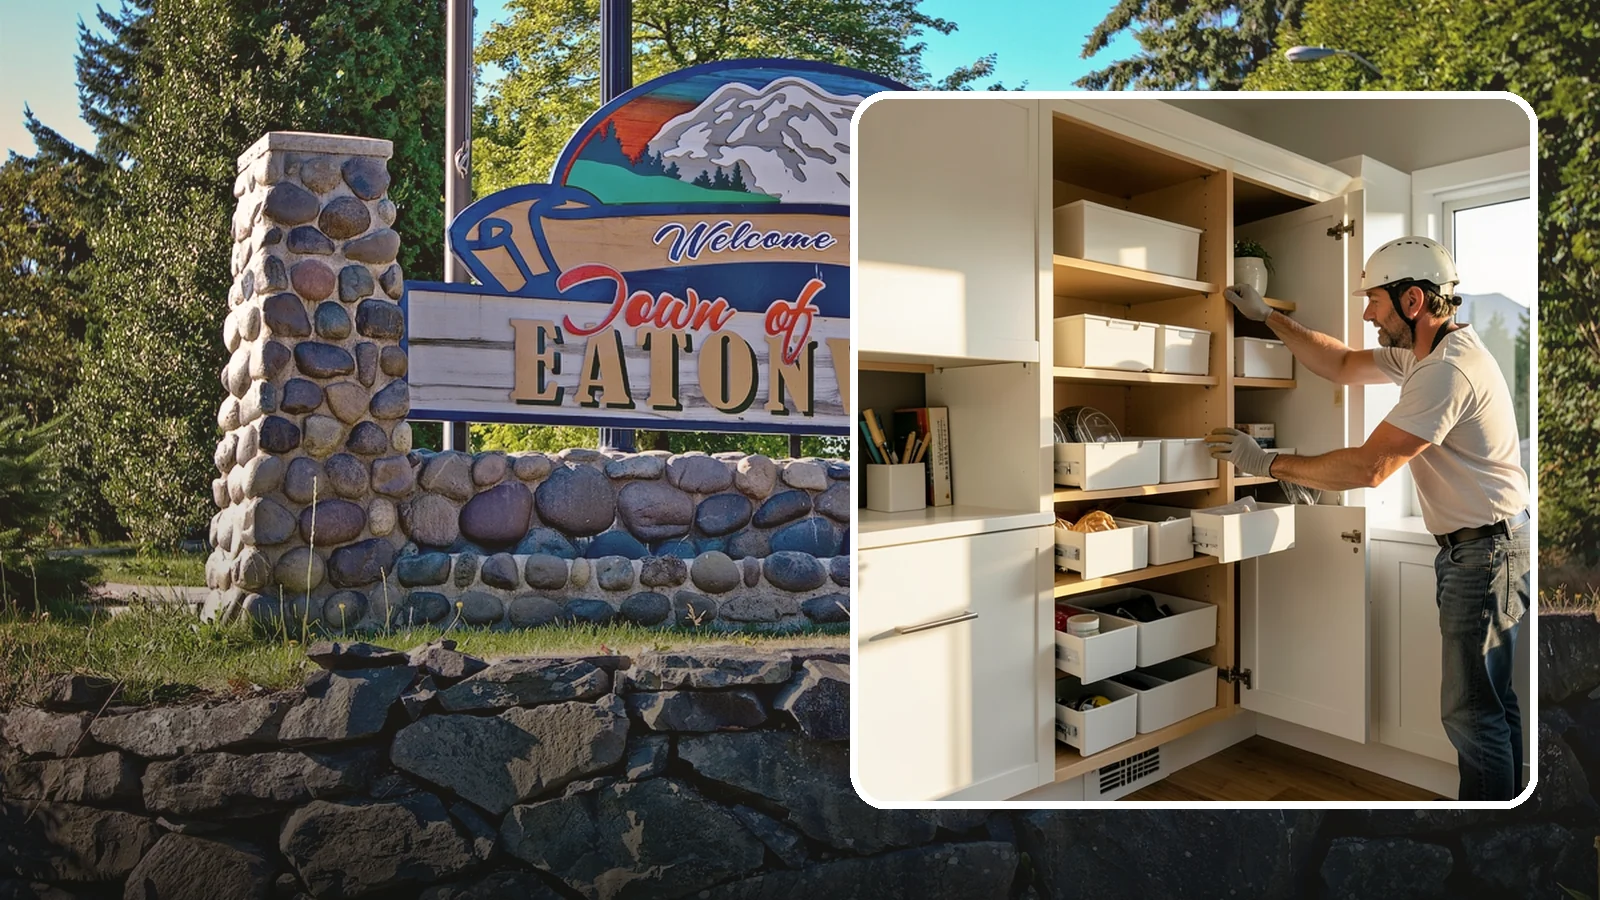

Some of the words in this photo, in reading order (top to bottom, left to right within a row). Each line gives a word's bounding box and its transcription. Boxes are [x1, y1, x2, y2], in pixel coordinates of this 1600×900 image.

[653, 220, 838, 263] Welcome
[556, 263, 737, 336] Town
[764, 278, 826, 365] of
